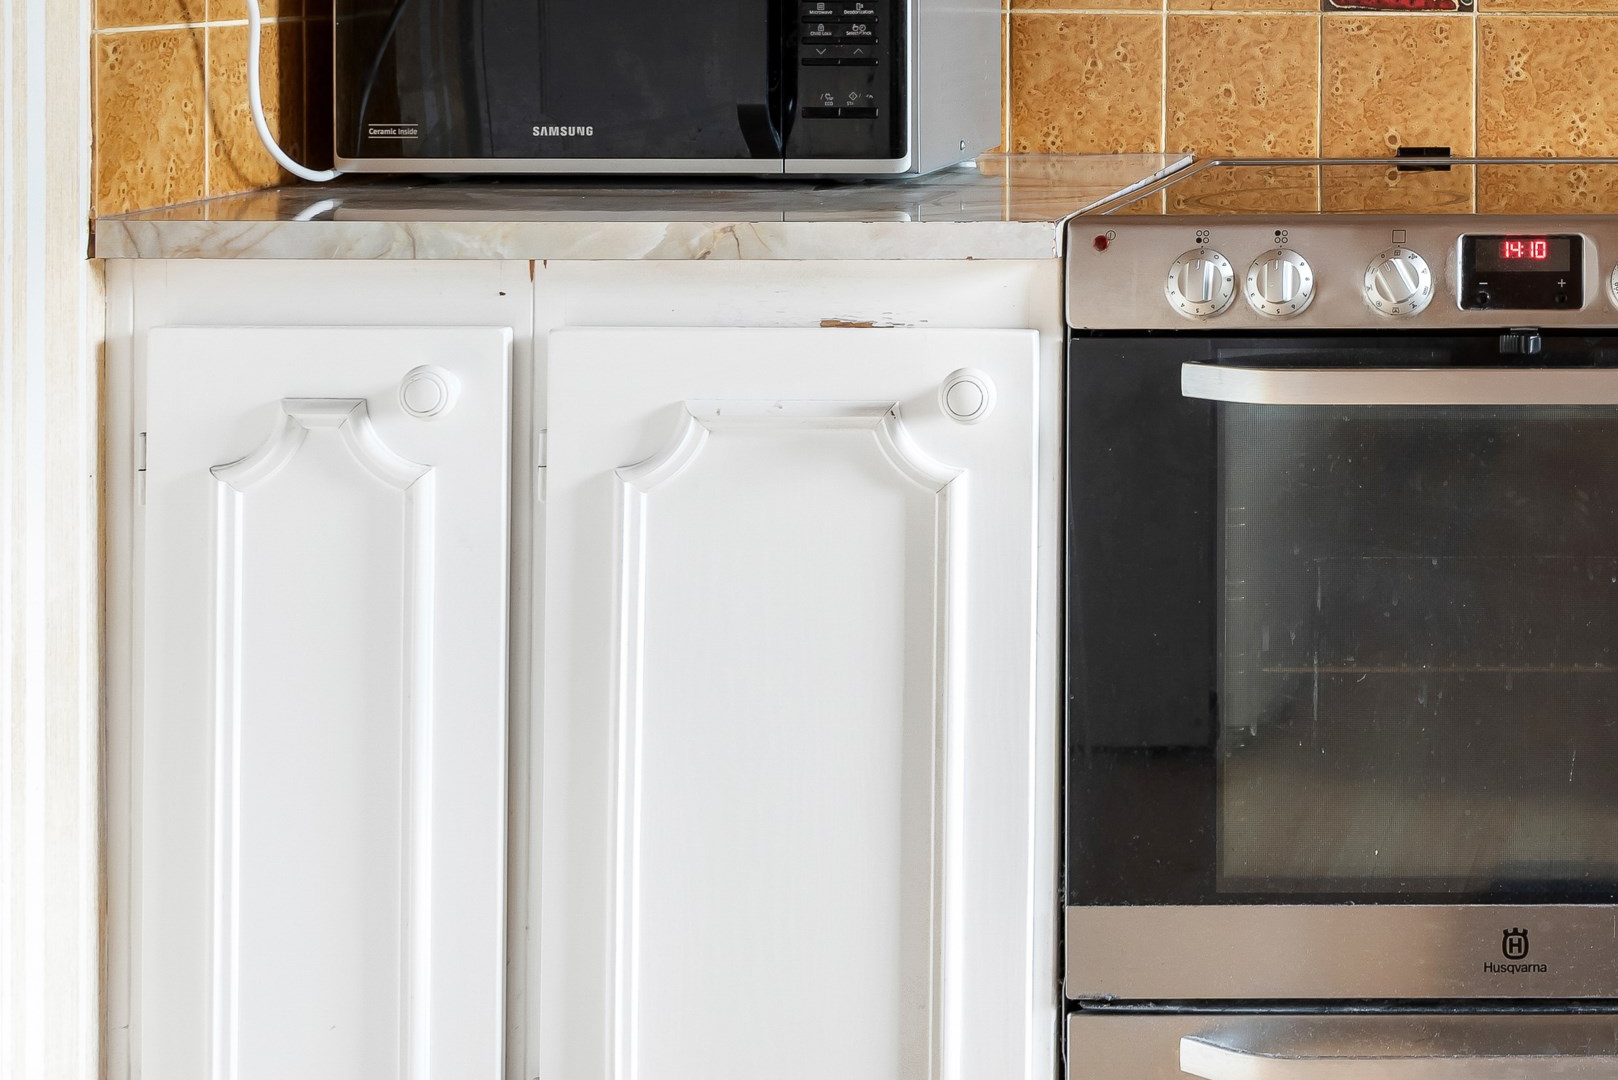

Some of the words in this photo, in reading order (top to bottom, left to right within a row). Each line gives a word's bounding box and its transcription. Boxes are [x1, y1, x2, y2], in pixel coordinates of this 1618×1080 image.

[533, 126, 593, 136] SAMSUNG
[1505, 241, 1546, 258] 14:10
[1483, 962, 1547, 975] Husqvarna
